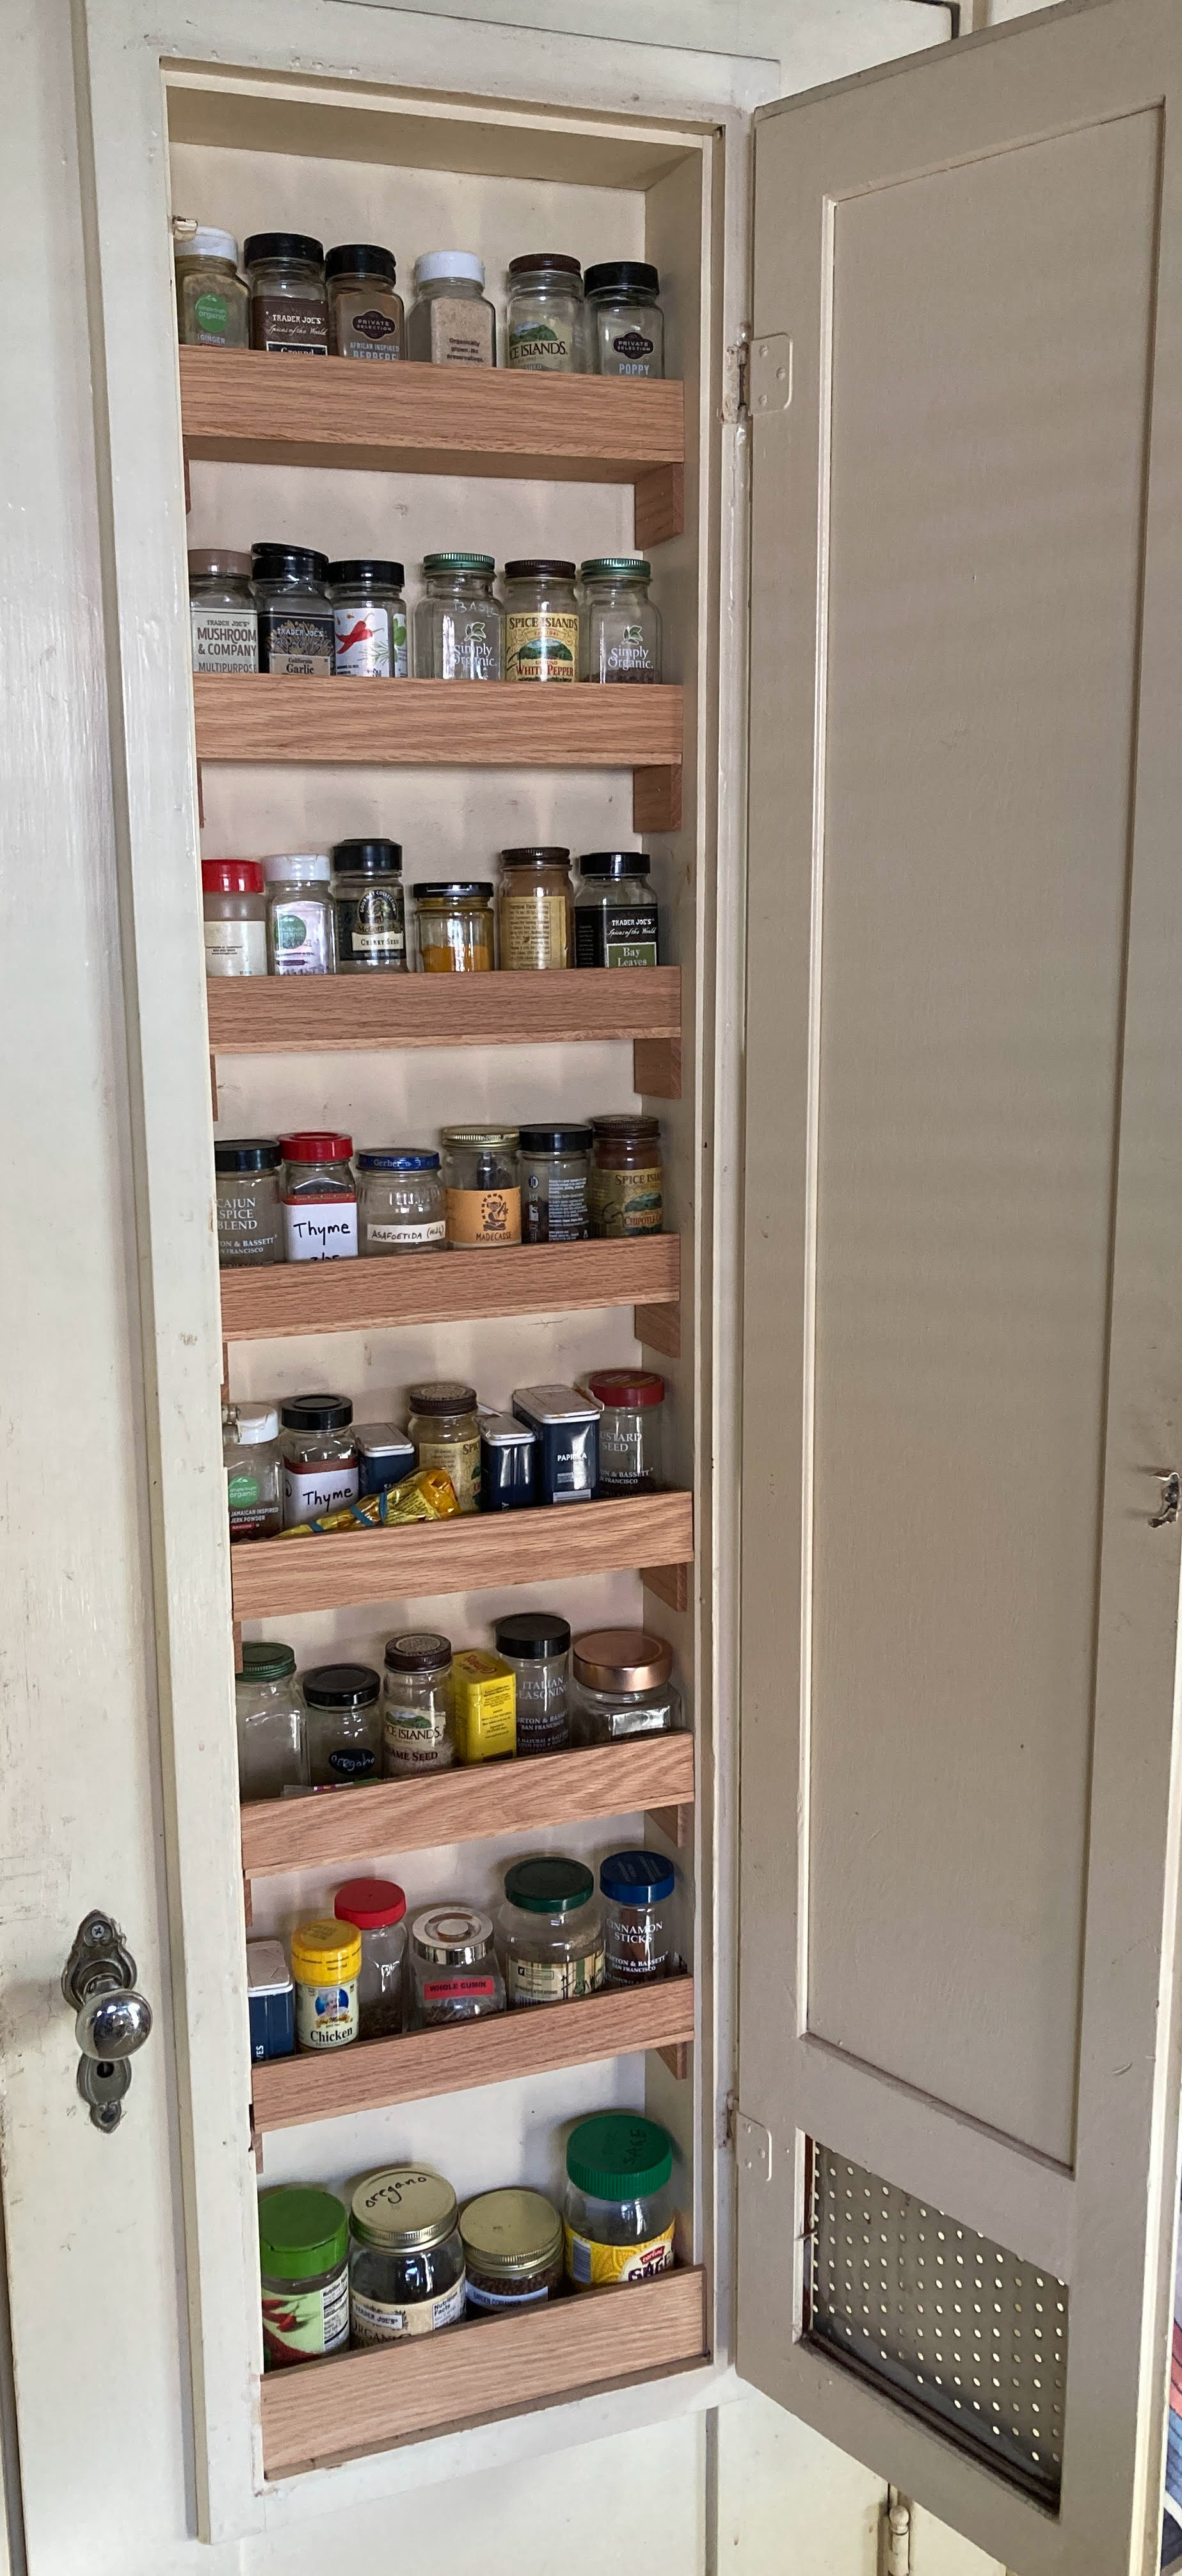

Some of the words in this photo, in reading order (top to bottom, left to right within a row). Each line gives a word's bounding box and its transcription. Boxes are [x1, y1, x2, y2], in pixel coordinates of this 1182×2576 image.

[198, 310, 226, 321] organic
[272, 314, 301, 323] TRADER
[302, 316, 321, 325] JOE'S
[266, 325, 288, 334] Spices
[288, 326, 298, 337] of
[310, 327, 328, 336] World
[200, 334, 225, 344] GINGER
[449, 337, 480, 346] Organically
[619, 364, 649, 375] POPPY
[509, 618, 538, 629] SPICE
[197, 627, 256, 644] MUSHROOM
[277, 627, 303, 636] TRADER
[198, 643, 205, 655] &
[208, 643, 256, 656] COMPANY
[611, 645, 649, 660] simply
[198, 662, 257, 673] MULTIPURPOSE
[286, 663, 314, 674] Garlic
[516, 666, 542, 675] WHIT
[547, 664, 573, 676] PEPPER
[608, 928, 625, 938] Spices
[625, 928, 632, 938] of
[623, 947, 640, 958] Bay
[618, 958, 647, 967] Leaves
[615, 1175, 645, 1186] SPICE
[218, 1198, 256, 1210] CAJUN
[220, 1209, 253, 1219] SPICE
[218, 1220, 257, 1230] BLEND
[293, 1221, 351, 1245] Thyme
[243, 1237, 274, 1246] BASSETT
[600, 1432, 642, 1442] USTARD
[602, 1442, 628, 1452] SEED
[303, 1488, 353, 1512] Thyme
[412, 1751, 438, 1761] SEED
[607, 1919, 662, 1933] CINNAMON
[614, 1933, 651, 1943] STICKS
[430, 1983, 458, 1992] WHOLE
[310, 2027, 353, 2042] Chicken
[365, 2177, 427, 2207] oregano
